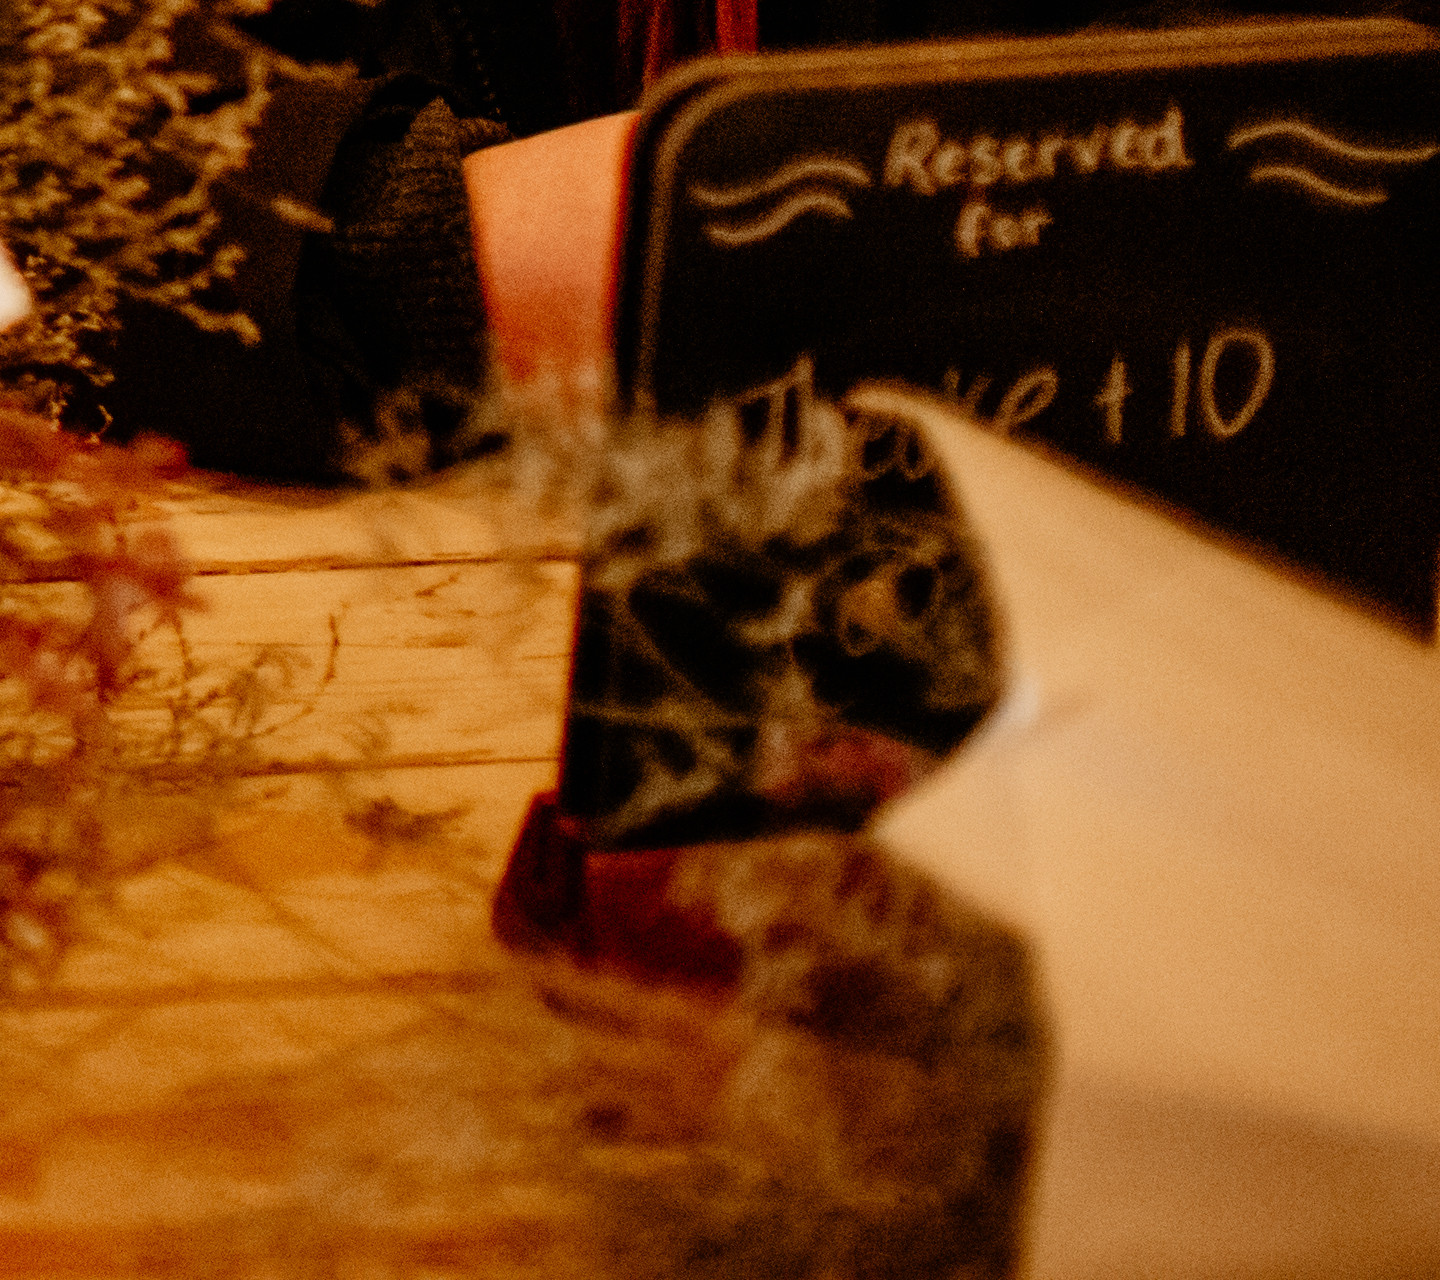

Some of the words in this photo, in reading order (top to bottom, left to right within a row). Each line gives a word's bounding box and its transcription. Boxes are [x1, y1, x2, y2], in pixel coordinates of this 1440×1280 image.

[883, 102, 1193, 194] Reserved
[955, 197, 1052, 258] for
[1171, 326, 1275, 438] 10
